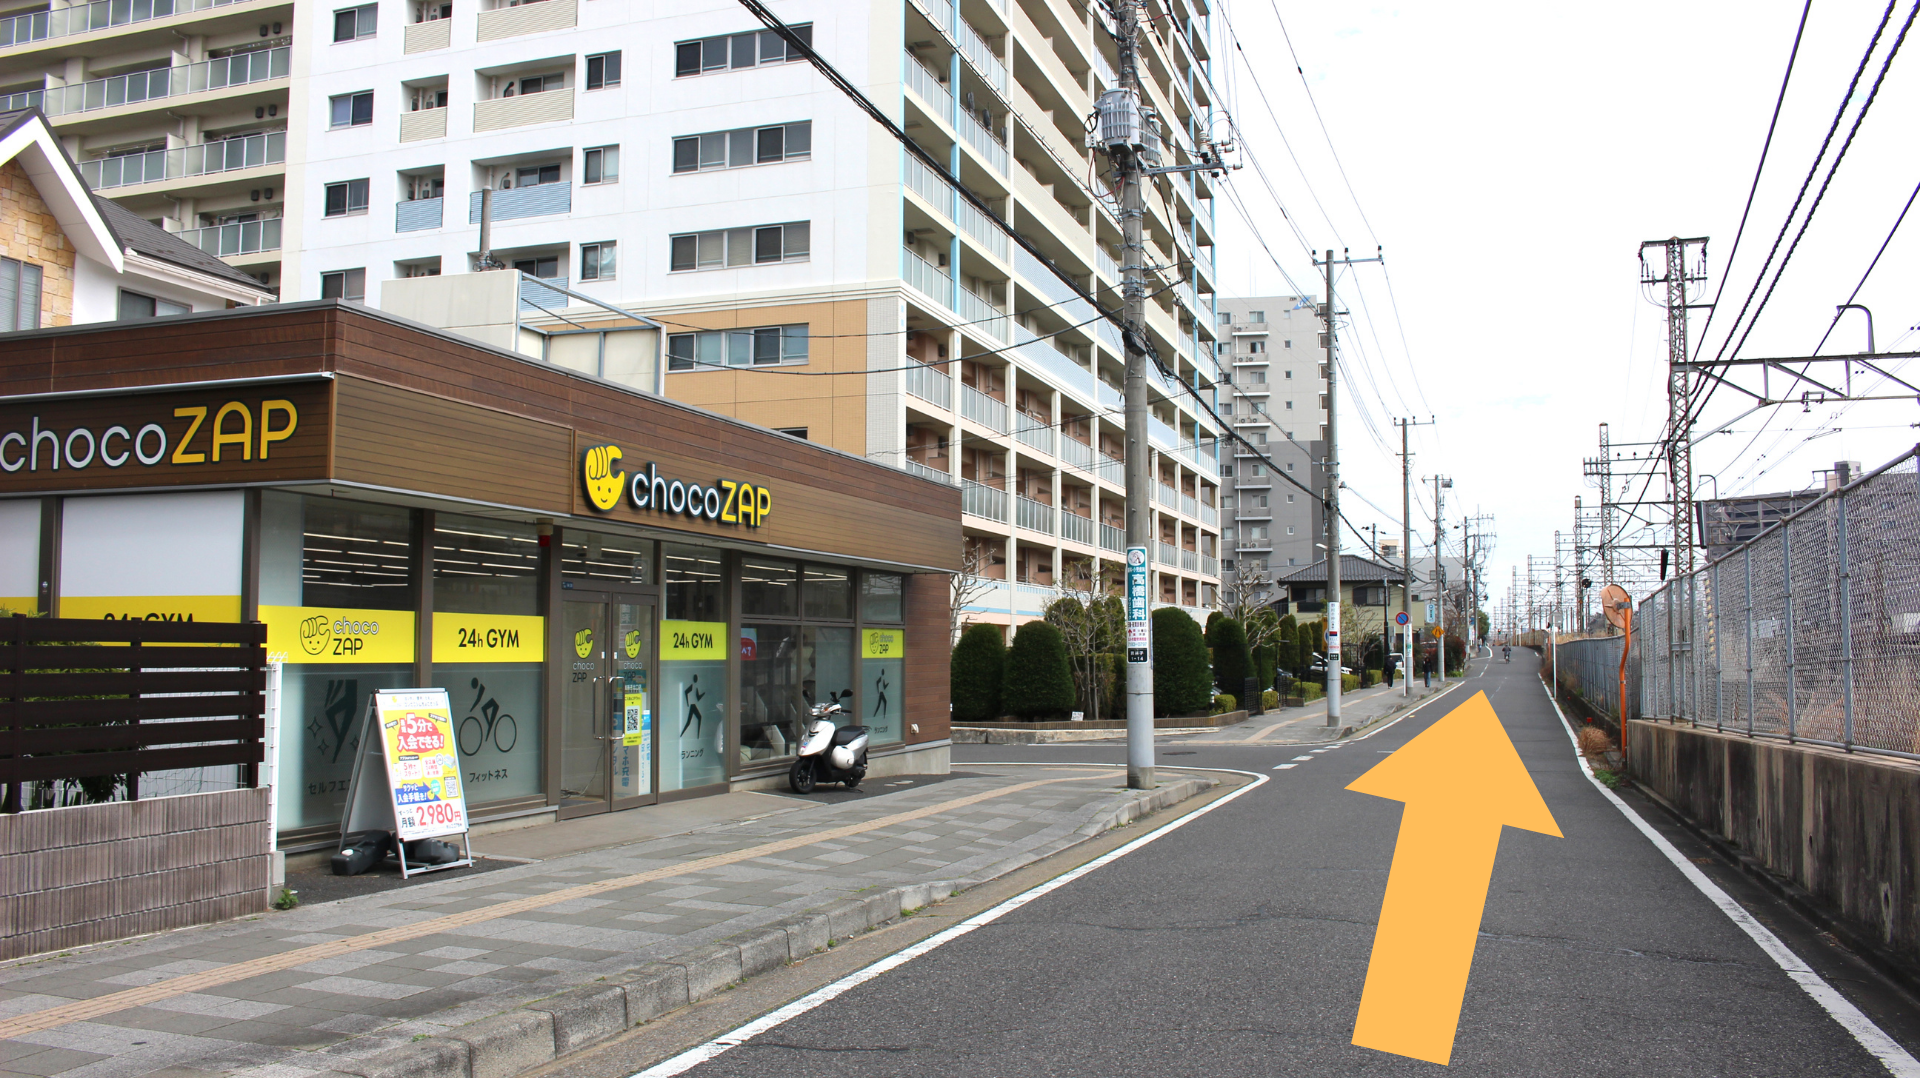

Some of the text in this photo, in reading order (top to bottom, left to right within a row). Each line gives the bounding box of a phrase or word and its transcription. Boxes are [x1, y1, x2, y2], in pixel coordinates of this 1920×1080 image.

[0, 399, 298, 473] chocoZAP
[631, 462, 772, 528] chocoZAP
[1131, 573, 1146, 620] 高橋歯科
[333, 616, 379, 635] choco
[333, 637, 364, 656] ZAP
[458, 628, 520, 649] 24h GYM
[673, 633, 713, 650] 24h GYM
[573, 661, 595, 670] choco
[572, 672, 587, 683] ZAP
[681, 748, 704, 760] ランニング
[469, 768, 508, 783] フィットネス
[308, 777, 352, 795] セルフエ
